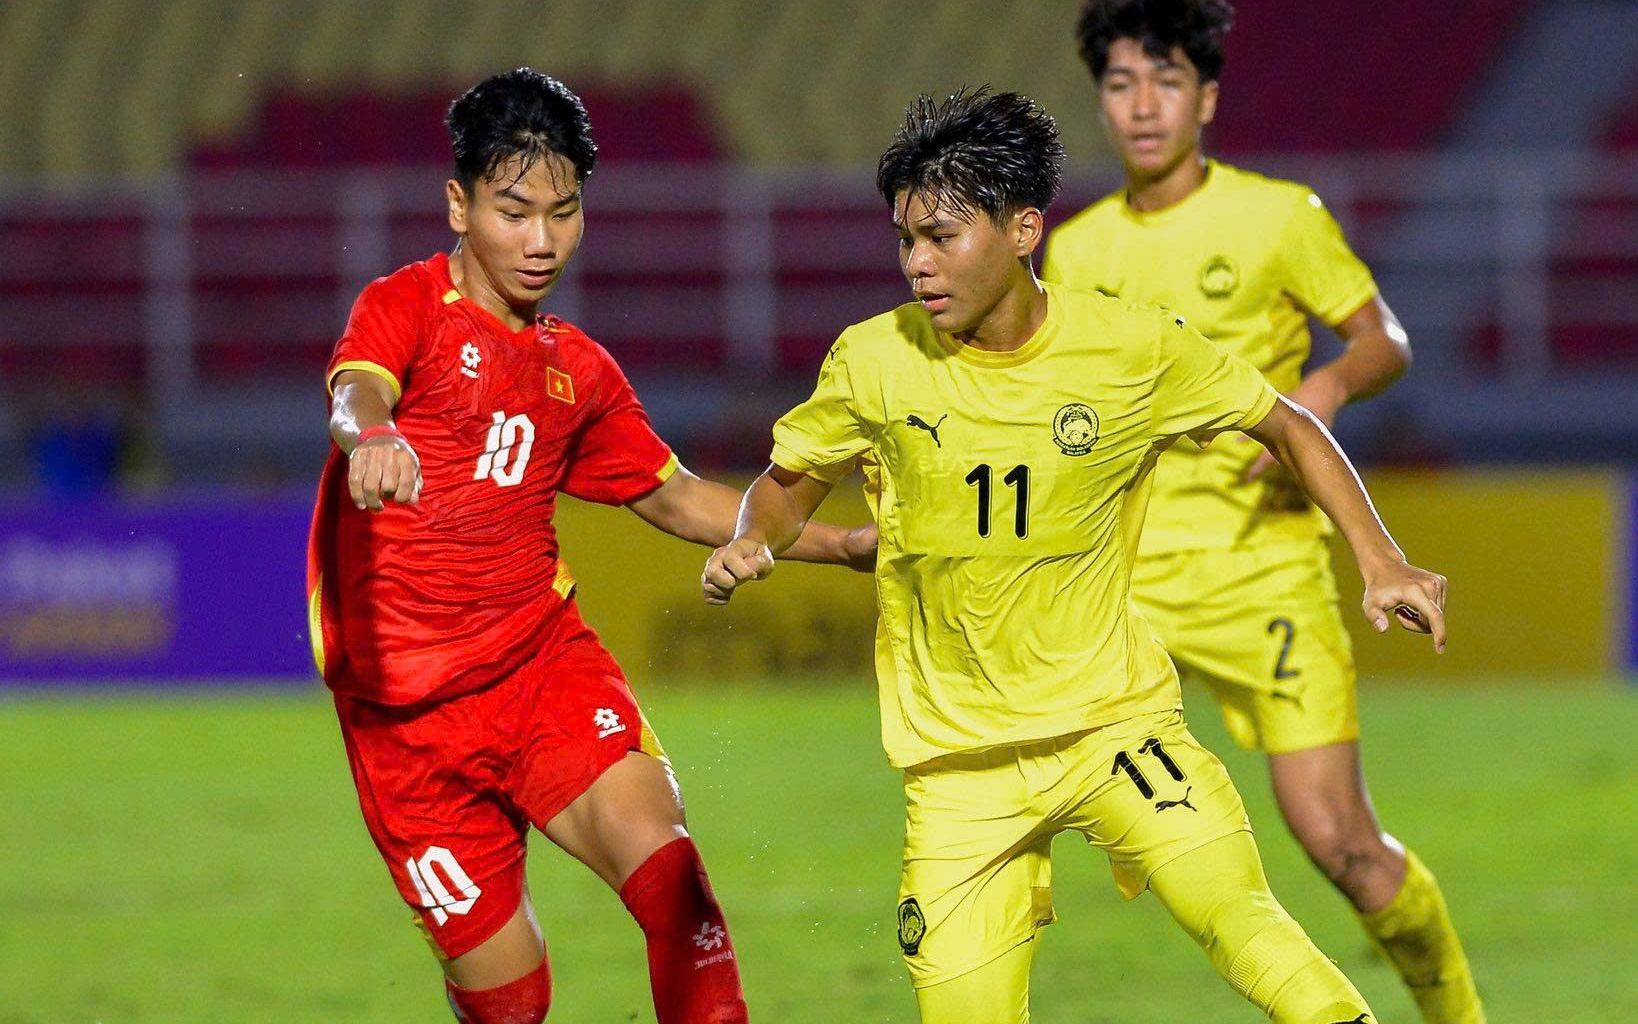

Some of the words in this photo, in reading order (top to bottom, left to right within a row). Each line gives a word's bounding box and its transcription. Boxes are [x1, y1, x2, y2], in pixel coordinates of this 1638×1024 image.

[473, 410, 535, 487] 10
[965, 463, 1031, 539] 11
[1267, 617, 1300, 680] 2
[1111, 737, 1187, 799] 11
[406, 845, 482, 927] 10
